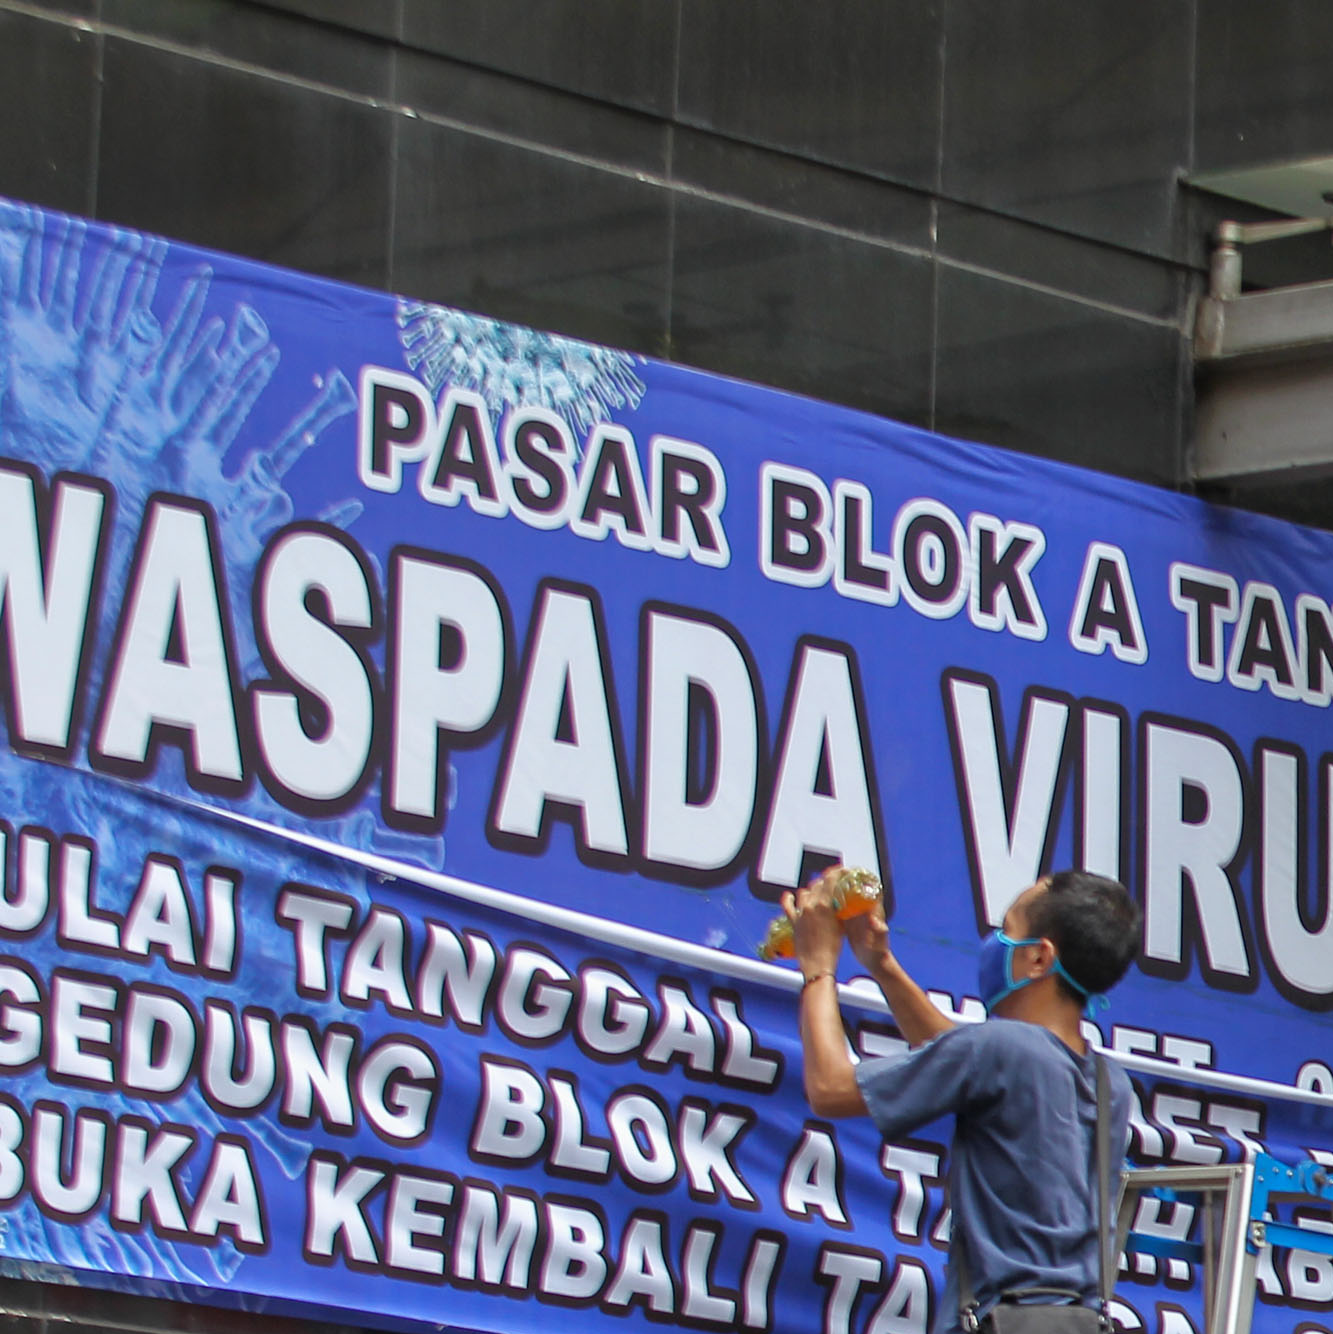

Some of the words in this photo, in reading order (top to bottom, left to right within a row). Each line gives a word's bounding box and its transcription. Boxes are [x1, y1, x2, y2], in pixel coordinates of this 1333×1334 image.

[359, 365, 729, 566] PASAR
[760, 463, 1046, 641] BLOK
[1070, 543, 1148, 664] A
[0, 962, 435, 1141] GEDUNG
[471, 1062, 755, 1203] BLOK
[783, 1128, 848, 1225] A
[278, 891, 781, 1087] TANGGAL
[305, 1157, 781, 1330] KEMBALI
